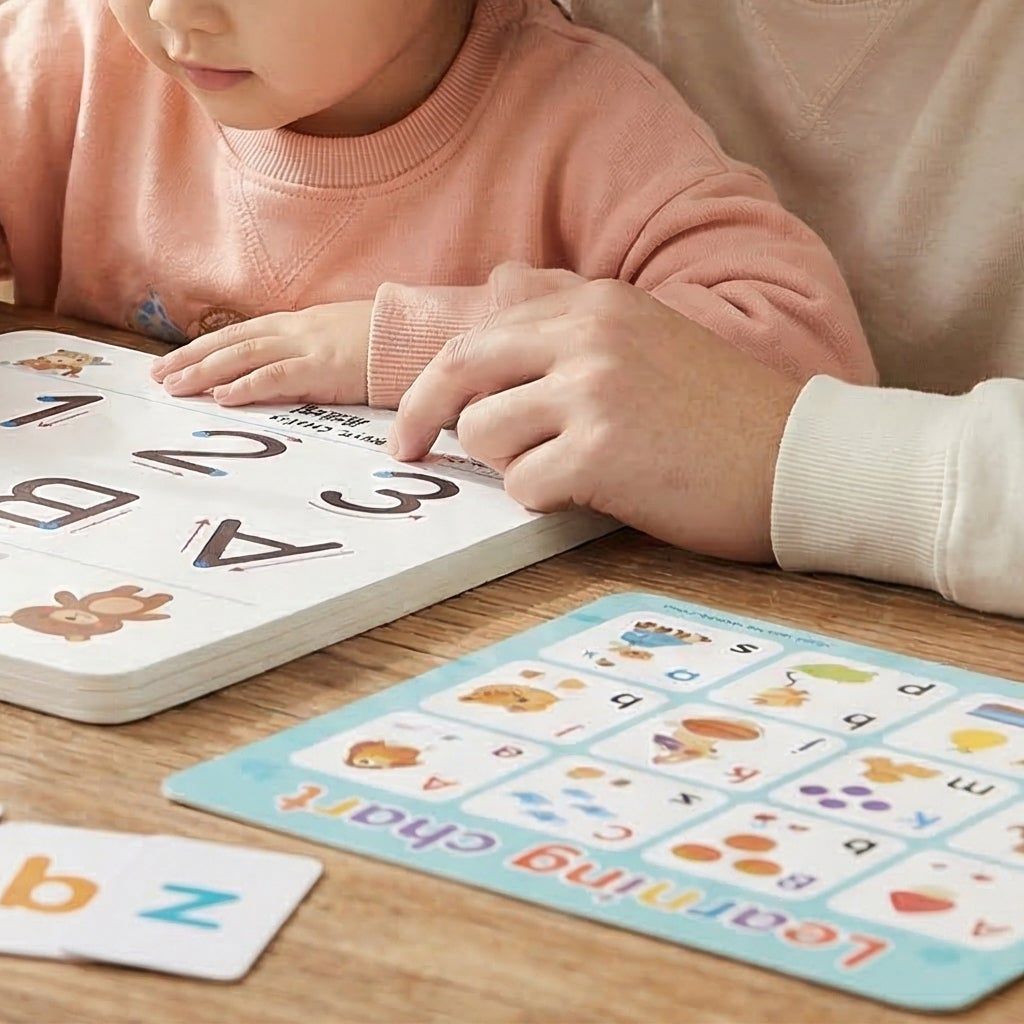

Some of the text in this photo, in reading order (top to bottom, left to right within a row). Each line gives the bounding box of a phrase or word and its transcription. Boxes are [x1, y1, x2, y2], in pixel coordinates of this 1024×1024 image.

[0, 395, 104, 427] 1
[131, 430, 288, 476] 2
[320, 471, 461, 514] 3
[193, 519, 343, 568] A
[276, 784, 888, 968] Learning chart
